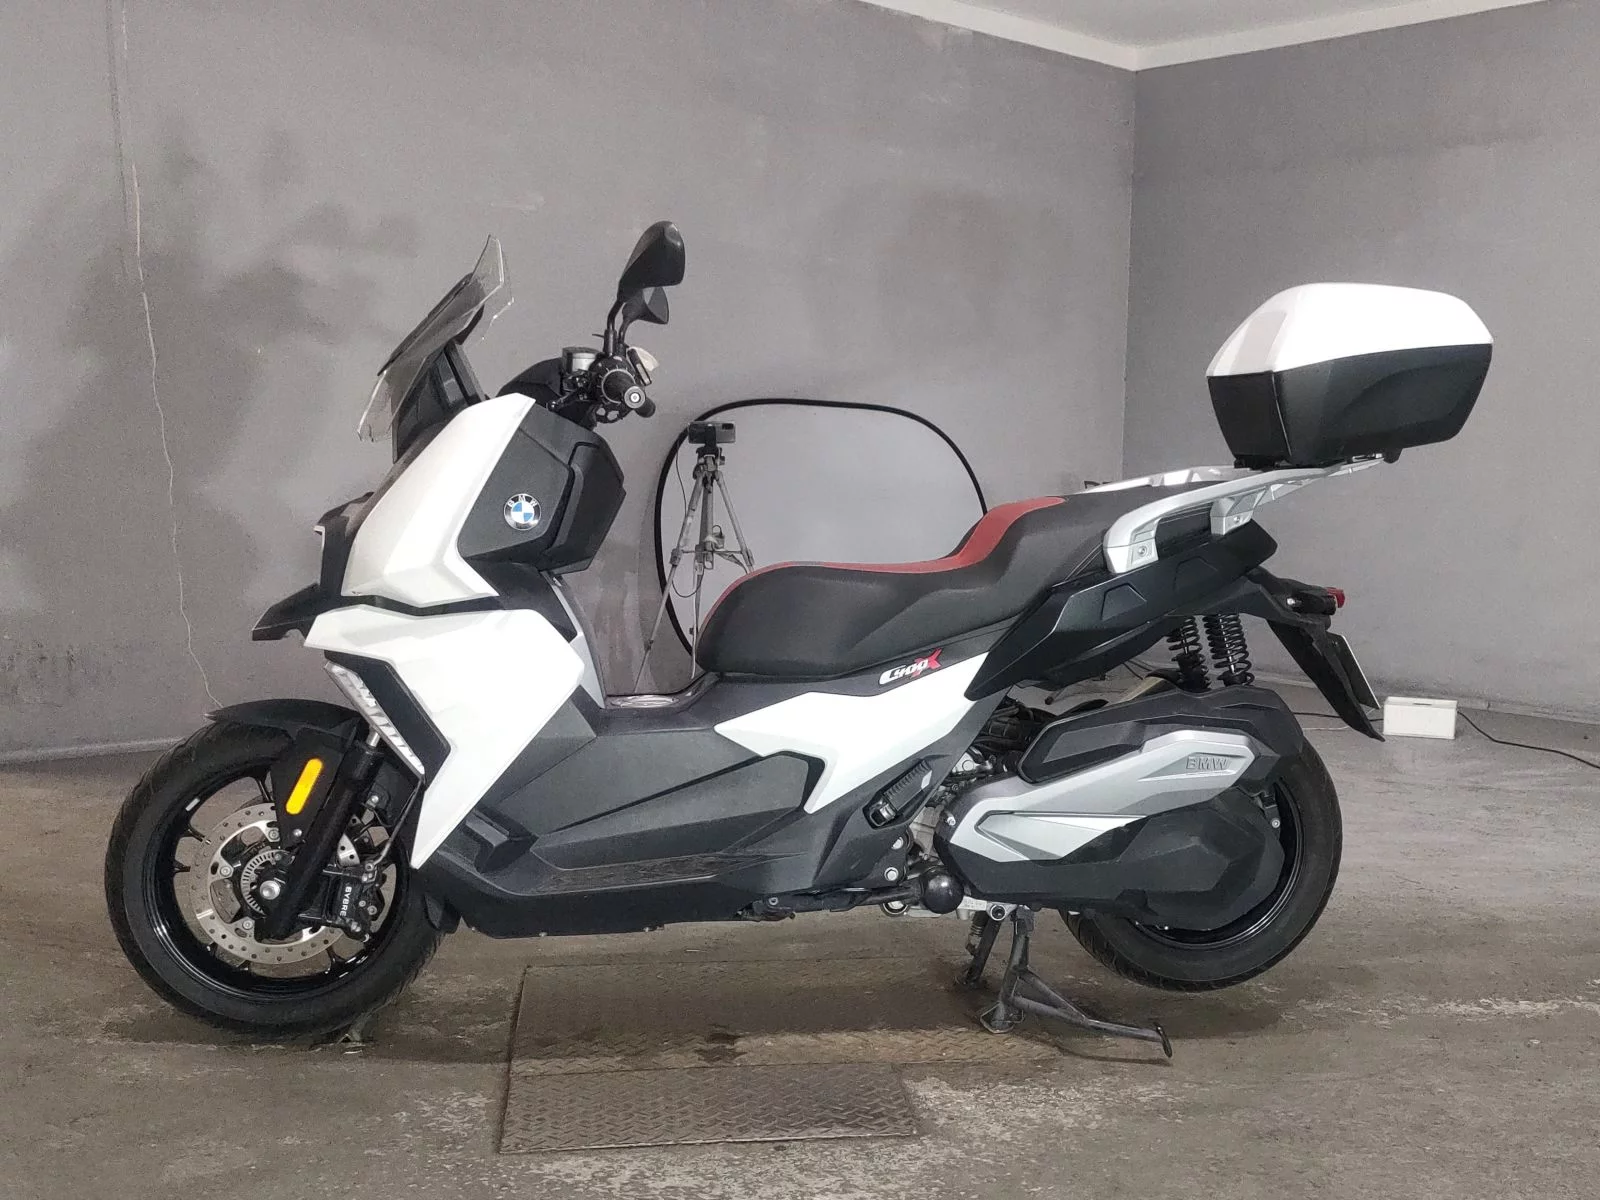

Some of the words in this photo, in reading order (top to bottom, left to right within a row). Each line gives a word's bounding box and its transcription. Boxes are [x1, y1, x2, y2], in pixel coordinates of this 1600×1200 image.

[507, 494, 538, 507] BMW
[1186, 756, 1231, 770] BMW
[340, 886, 352, 917] BYBRE
